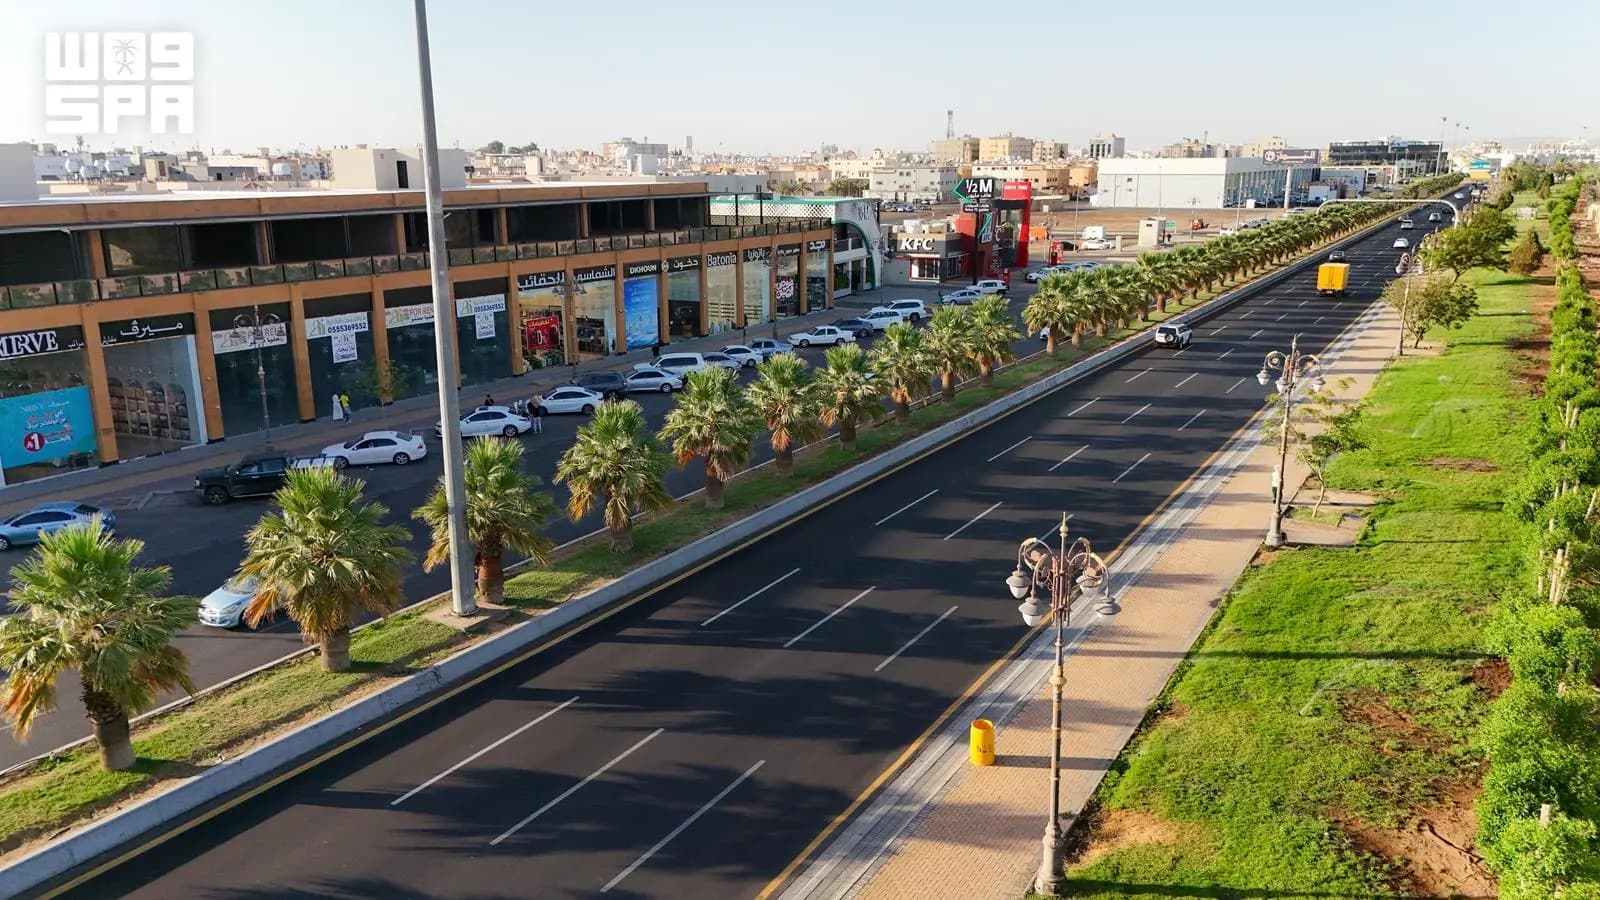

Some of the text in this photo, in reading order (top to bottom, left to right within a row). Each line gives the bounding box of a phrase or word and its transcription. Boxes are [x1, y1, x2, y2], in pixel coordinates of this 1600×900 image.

[979, 179, 993, 193] M
[899, 238, 934, 251] KFC
[707, 252, 737, 267] Batonia
[629, 264, 657, 274] DKHOUN
[422, 305, 434, 315] REN
[327, 322, 367, 334] 0555369552
